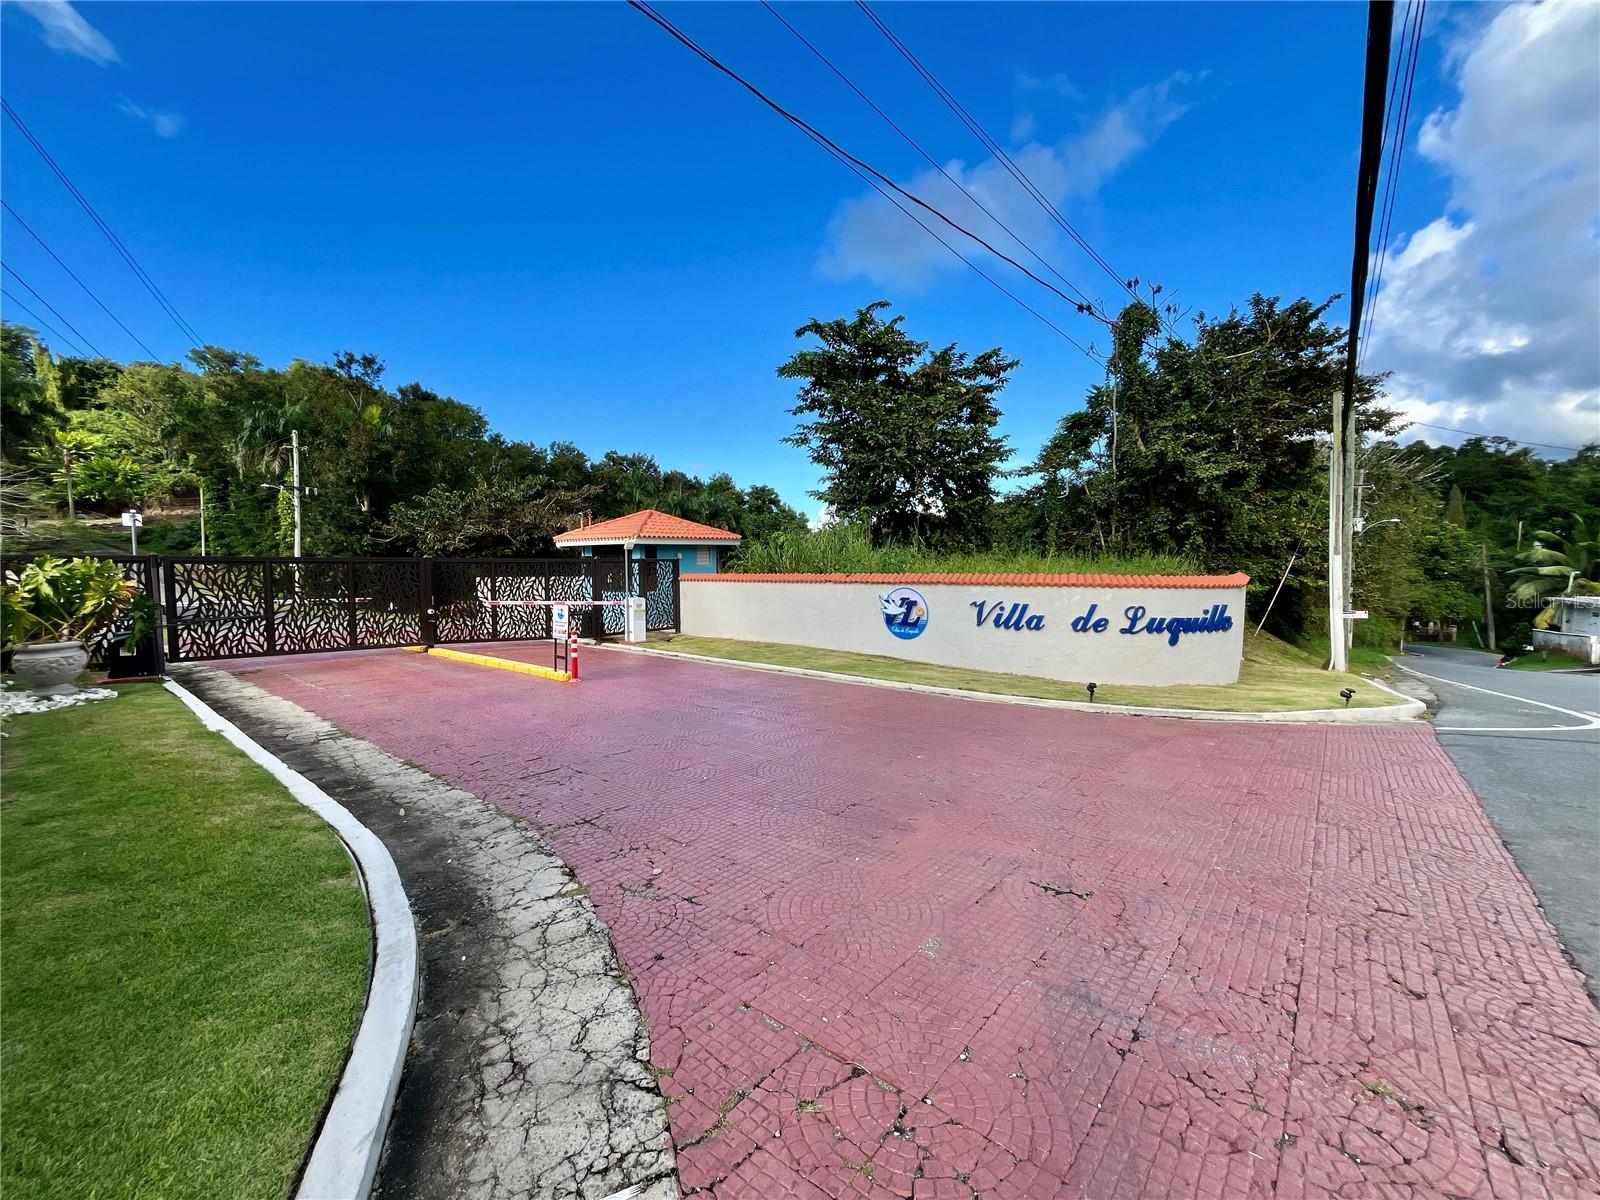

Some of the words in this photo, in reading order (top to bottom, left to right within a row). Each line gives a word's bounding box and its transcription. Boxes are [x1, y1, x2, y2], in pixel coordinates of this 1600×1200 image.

[970, 599, 1045, 632] Villa
[1071, 604, 1109, 633] de
[1119, 604, 1233, 646] Luquillo
